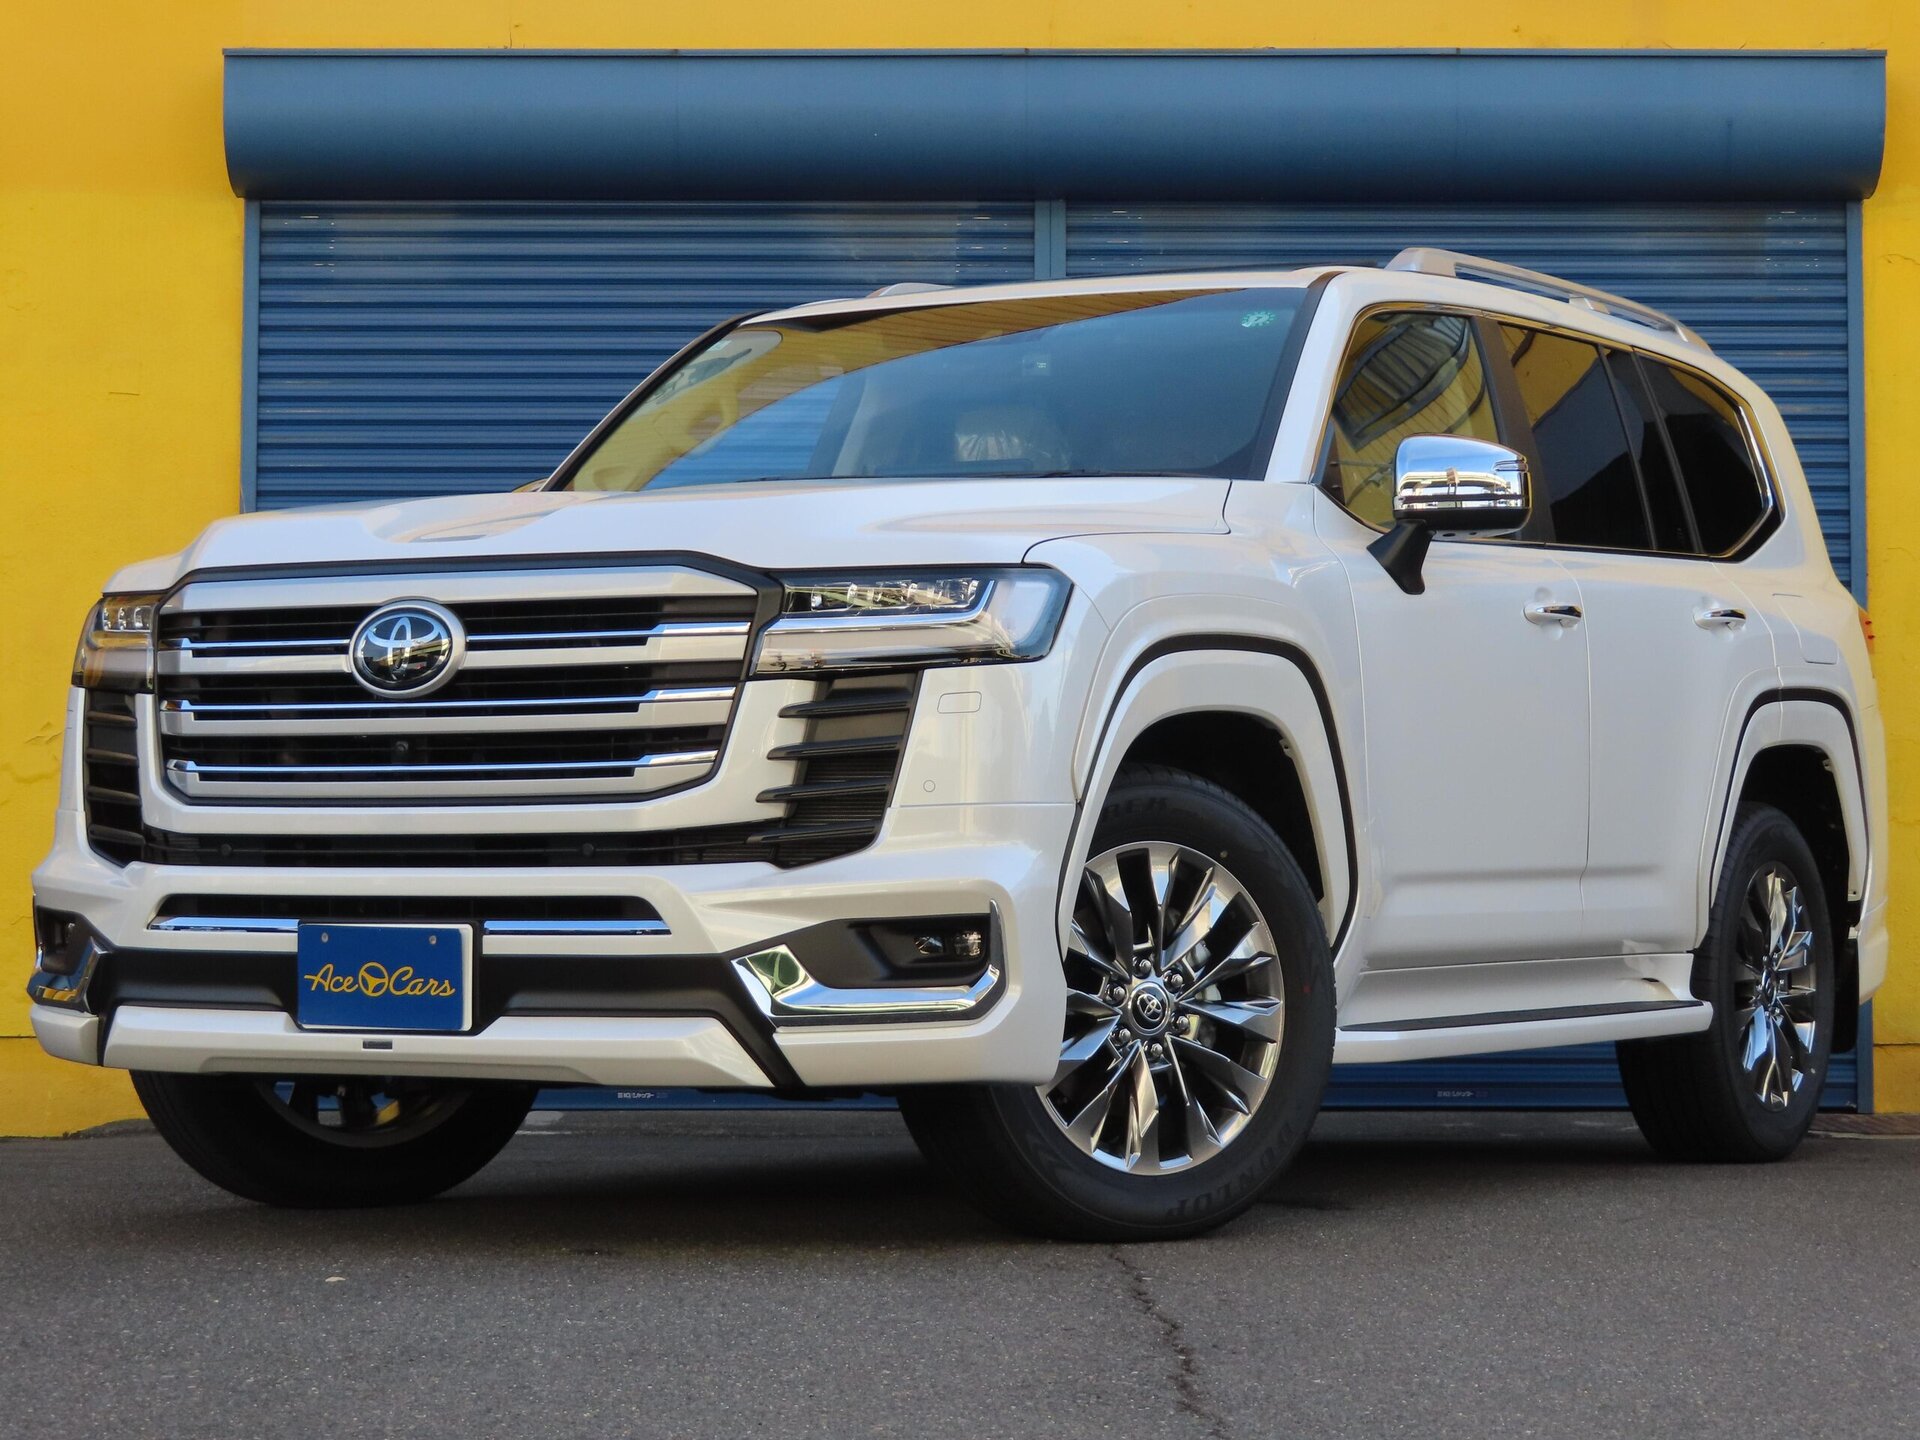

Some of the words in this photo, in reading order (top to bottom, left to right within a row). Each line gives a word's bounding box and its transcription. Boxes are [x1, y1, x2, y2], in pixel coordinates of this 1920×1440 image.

[304, 963, 358, 992] Ace
[389, 966, 455, 996] Cars
[1167, 1122, 1295, 1218] DUNLOP
